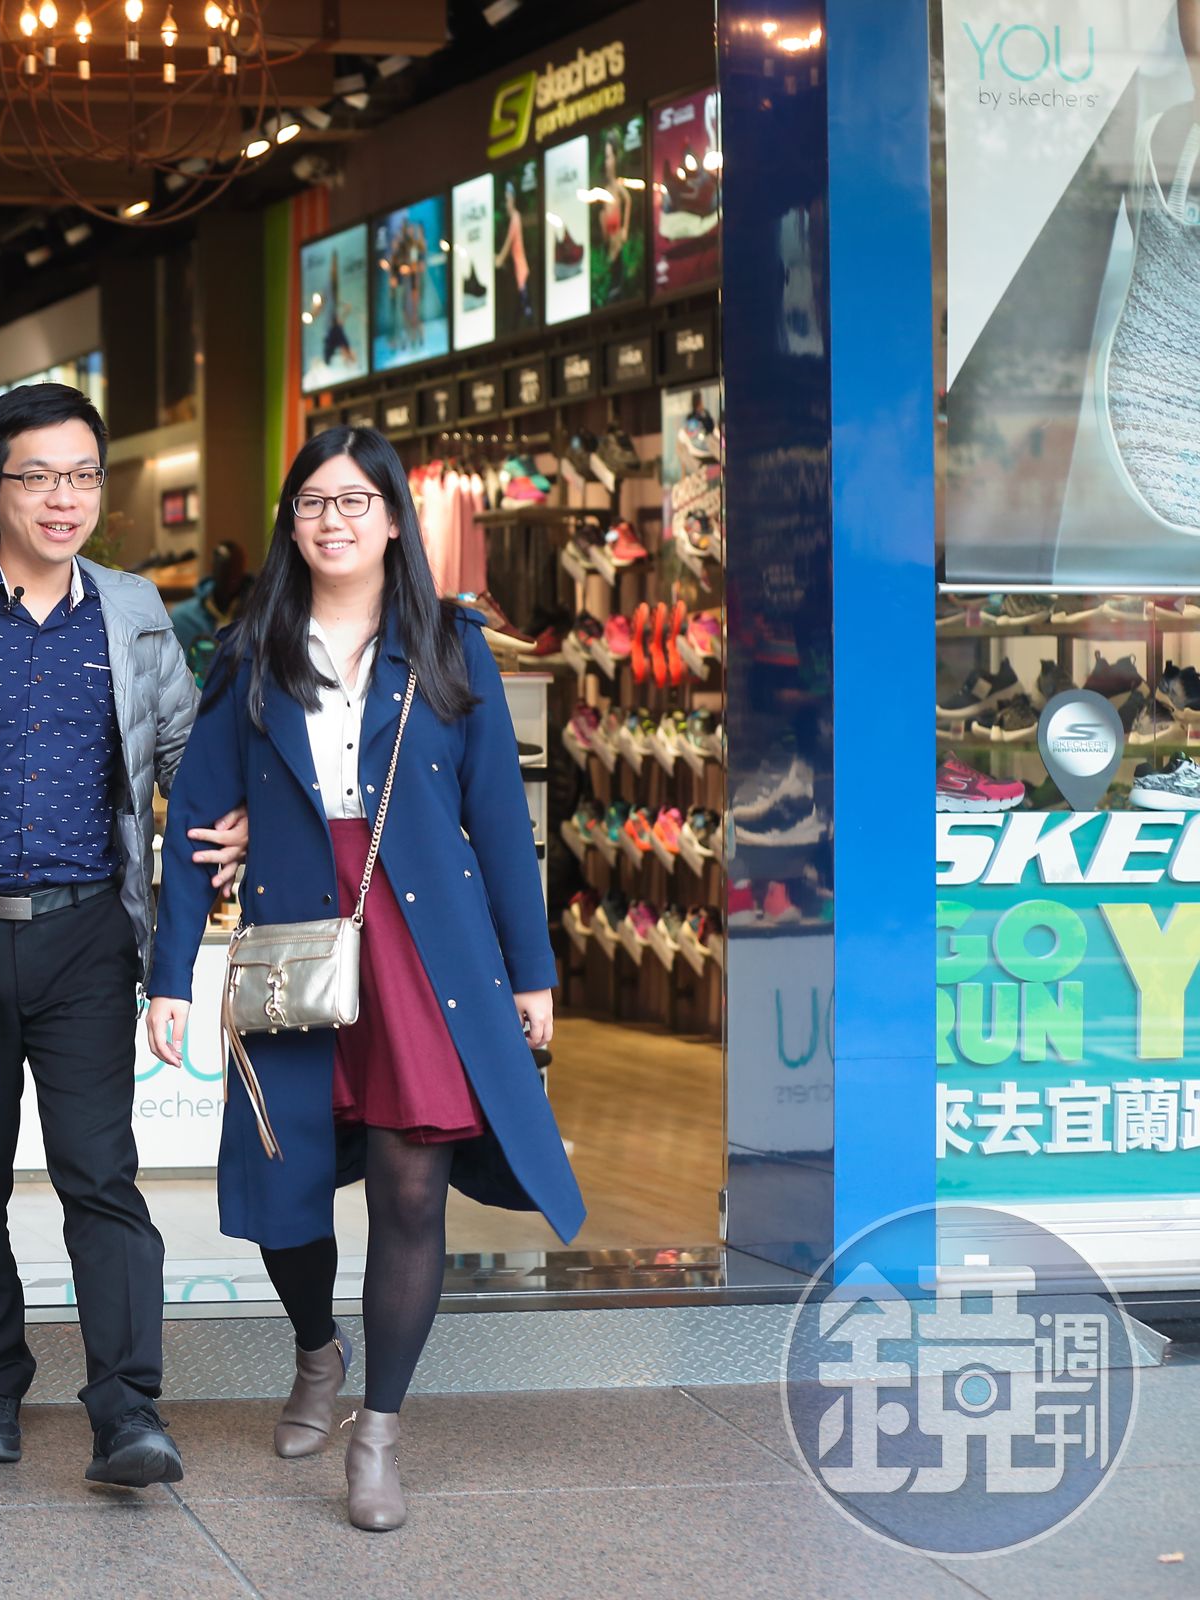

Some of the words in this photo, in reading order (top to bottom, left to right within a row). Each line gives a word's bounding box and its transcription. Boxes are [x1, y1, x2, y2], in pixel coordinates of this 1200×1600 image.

[536, 41, 625, 108] skechers
[961, 22, 1095, 83] YOU
[978, 86, 1002, 110] by
[1008, 88, 1097, 108] skechers
[131, 1091, 225, 1118] echer
